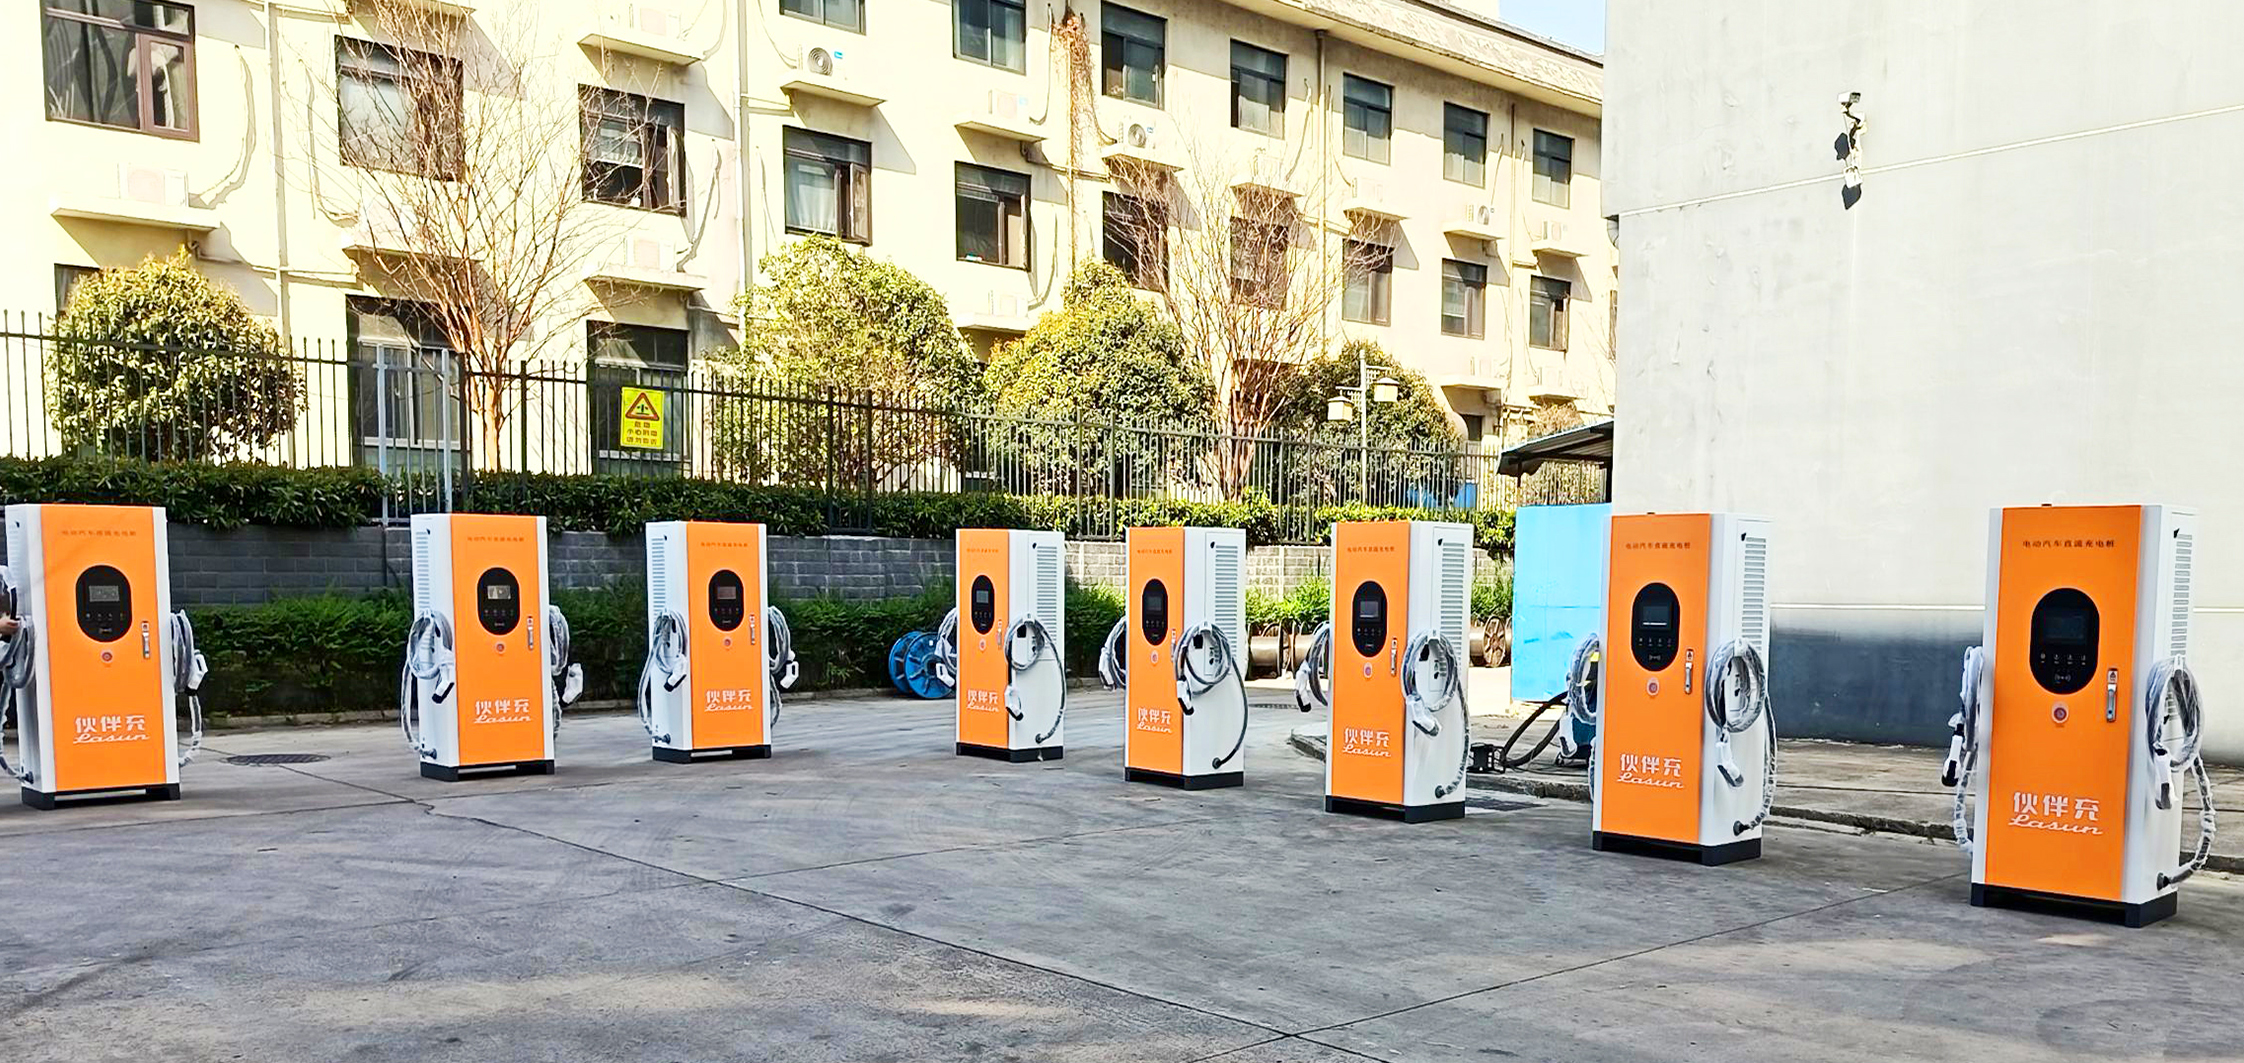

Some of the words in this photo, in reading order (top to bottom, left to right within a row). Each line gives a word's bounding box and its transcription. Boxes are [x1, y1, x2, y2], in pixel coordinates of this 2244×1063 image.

[706, 689, 751, 703] 伙伴充
[475, 698, 529, 715] 伙伴充
[75, 714, 146, 733] 伙伴充
[473, 714, 532, 724] Lasun
[73, 732, 150, 744] Lasun
[1344, 728, 1390, 748] 伙伴充
[1342, 743, 1392, 757] Lasun
[1620, 753, 1682, 777] 伙伴充
[1617, 771, 1684, 789] Lasun
[2013, 791, 2100, 821] 伙伴充
[2008, 814, 2103, 835] Lasun
